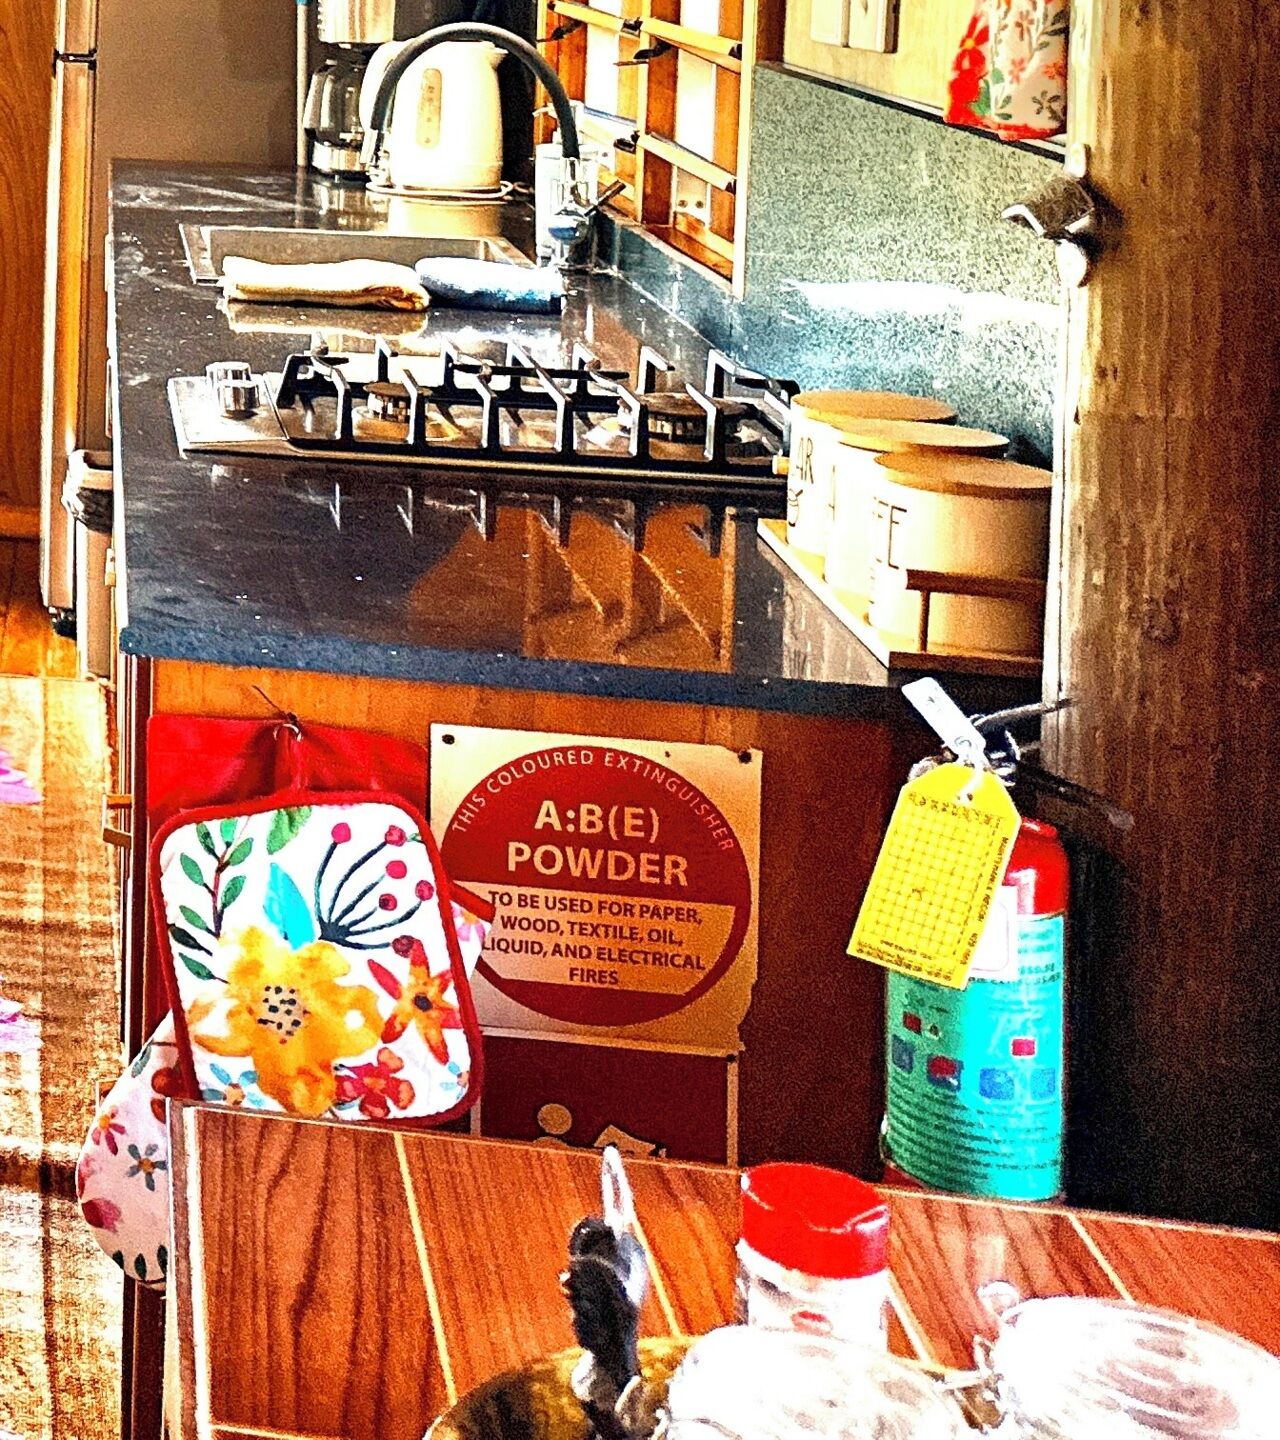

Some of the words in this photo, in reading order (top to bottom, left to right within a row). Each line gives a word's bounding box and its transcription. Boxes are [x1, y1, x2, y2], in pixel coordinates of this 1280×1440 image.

[451, 795, 487, 833] THIS
[486, 750, 594, 794] COLOURED
[604, 750, 735, 851] EXTINGUISHER
[534, 800, 660, 844] A:B(E)
[508, 841, 689, 886] POWDER
[488, 890, 513, 907] TO
[518, 893, 540, 909] BE
[544, 896, 597, 915] USED
[598, 900, 636, 917] FOR
[640, 904, 703, 925] PAPER,
[500, 915, 564, 936] WOOD,
[567, 921, 643, 943] TEXTILE,
[647, 928, 684, 947] OIL,
[482, 937, 548, 958] LIQUID,
[551, 943, 592, 960] AND
[596, 946, 706, 971] ELECTRICAL
[569, 967, 618, 984] FIRES
